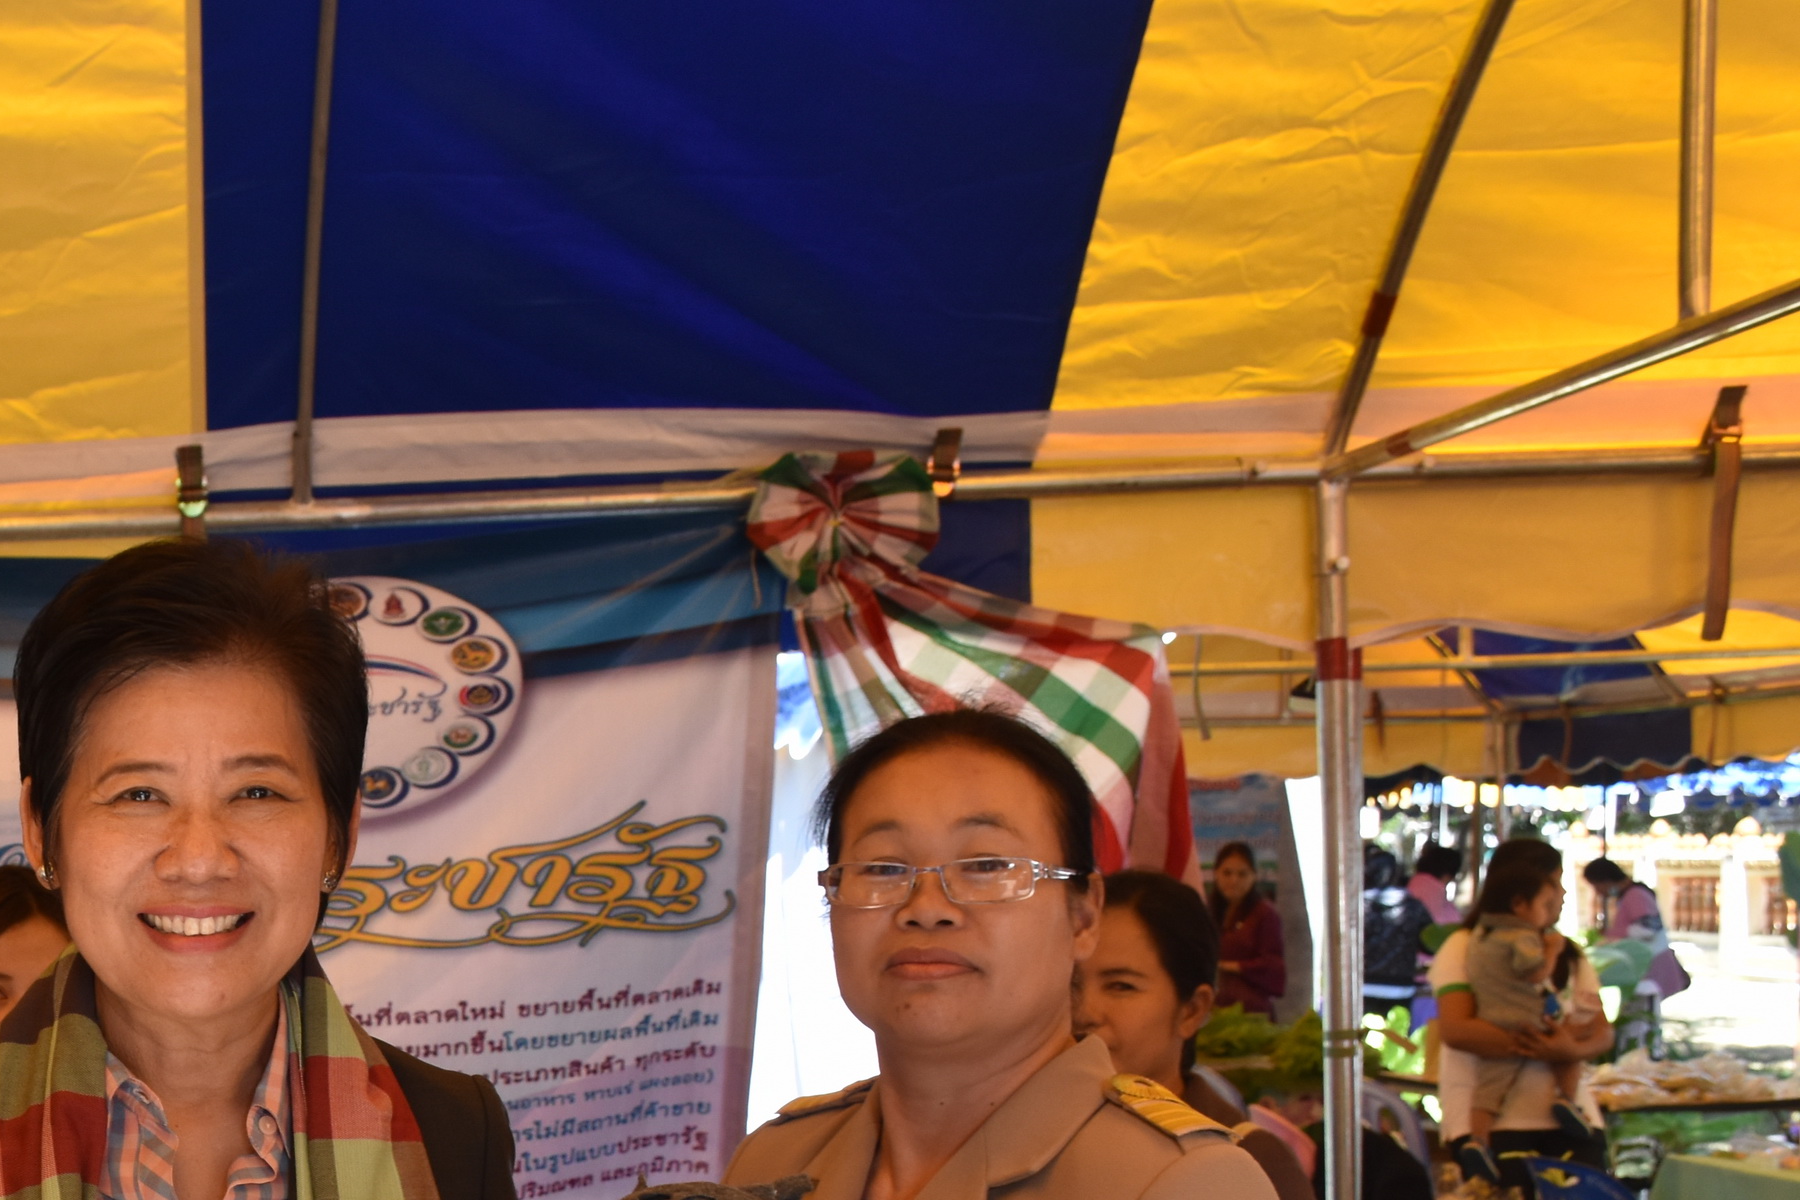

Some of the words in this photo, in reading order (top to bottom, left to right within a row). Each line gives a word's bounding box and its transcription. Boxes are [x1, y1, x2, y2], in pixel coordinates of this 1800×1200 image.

[518, 978, 721, 1018] ขยายพื้นที่ตลาดเดิม
[634, 1040, 716, 1072] ทุกระดับ
